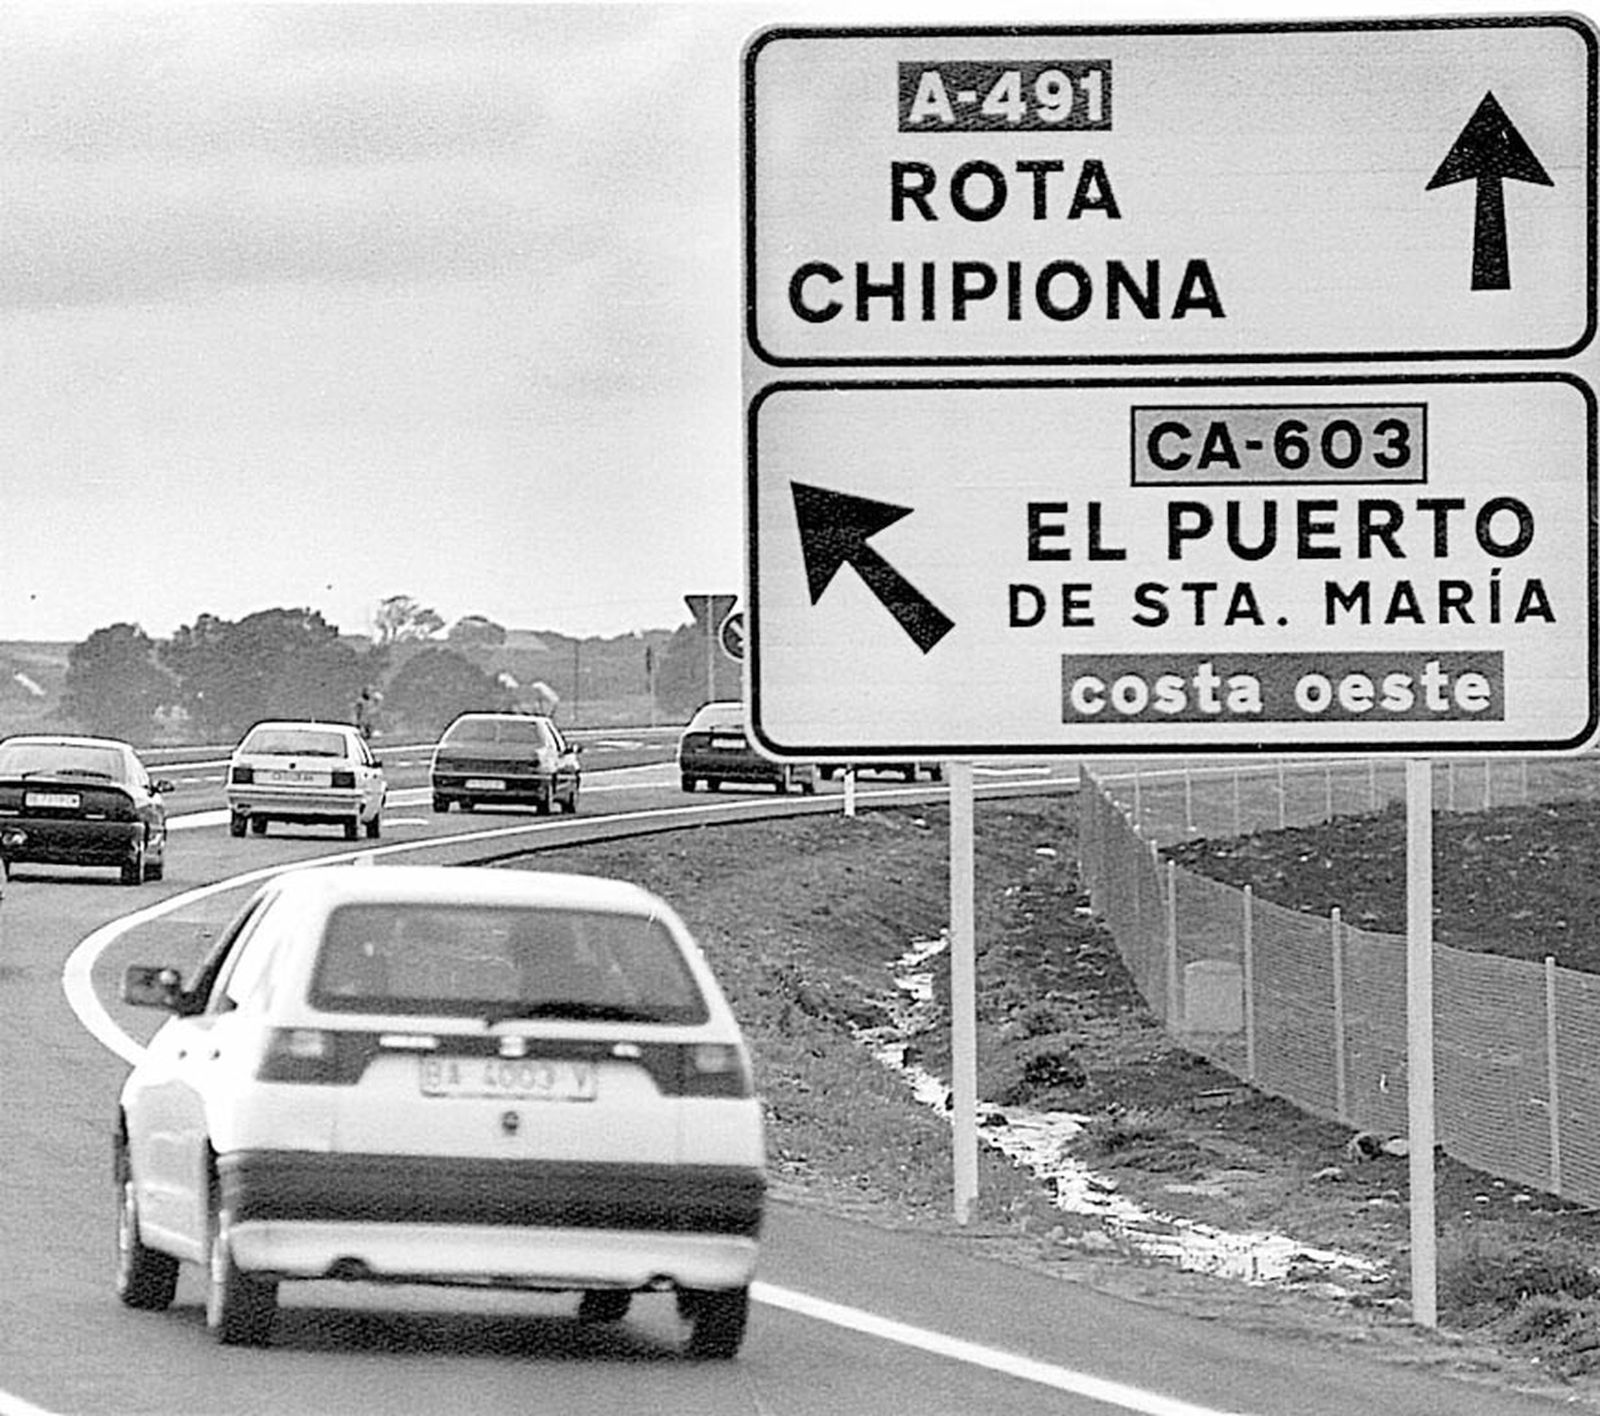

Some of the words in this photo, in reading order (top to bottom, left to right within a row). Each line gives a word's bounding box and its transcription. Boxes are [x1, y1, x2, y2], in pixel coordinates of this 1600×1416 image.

[908, 70, 1102, 123] A-491
[890, 159, 1122, 223] ROTA
[788, 258, 1227, 324] CHIPIONA
[1146, 417, 1412, 471] CA-603
[1027, 501, 1127, 562] EL
[1167, 496, 1535, 562] PUERTO
[1008, 583, 1095, 628] DE
[1132, 581, 1288, 628] STA.
[1325, 567, 1557, 626] MARÍA
[1070, 662, 1263, 715] costa
[1294, 660, 1491, 713] oeste
